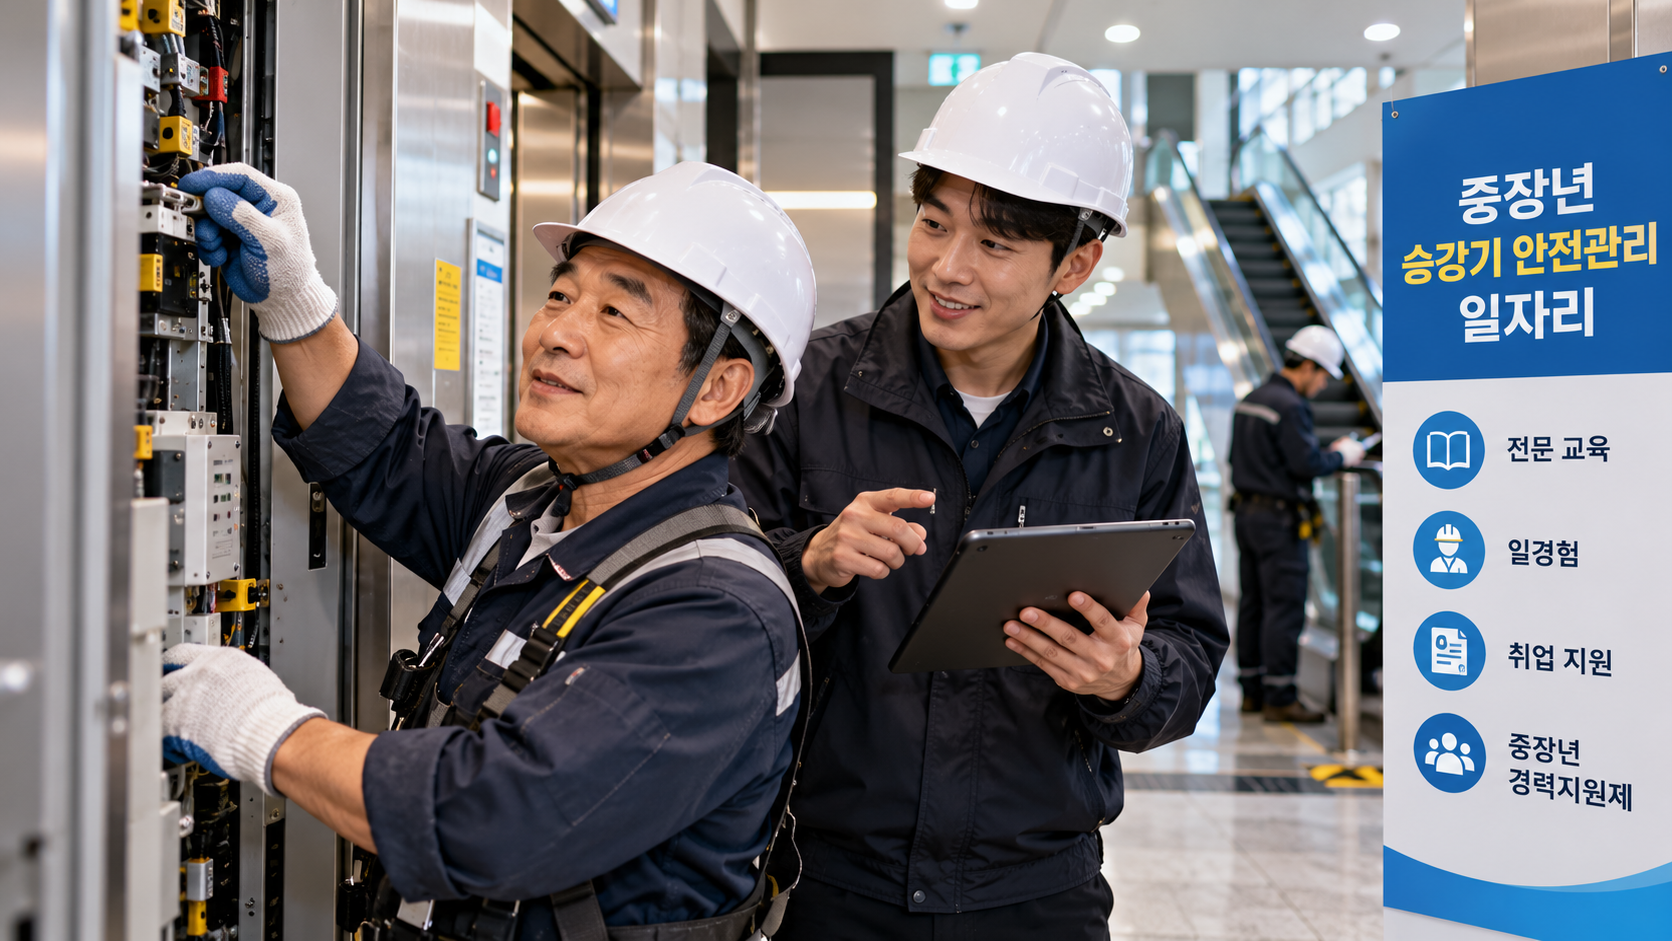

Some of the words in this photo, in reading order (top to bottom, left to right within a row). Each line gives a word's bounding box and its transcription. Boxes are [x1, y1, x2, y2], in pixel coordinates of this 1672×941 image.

[1459, 162, 1593, 225] 중장년
[1402, 237, 1501, 285] 승강기
[1512, 221, 1657, 276] 안전관리
[1459, 287, 1594, 343] 일자리
[1507, 435, 1553, 462] 전문
[1561, 435, 1611, 462] 교육
[1508, 538, 1579, 567] 일경험
[1508, 641, 1554, 672] 취업
[1563, 647, 1612, 677] 지원
[1508, 732, 1580, 766] 중장년
[1508, 768, 1632, 812] 경력지원제
